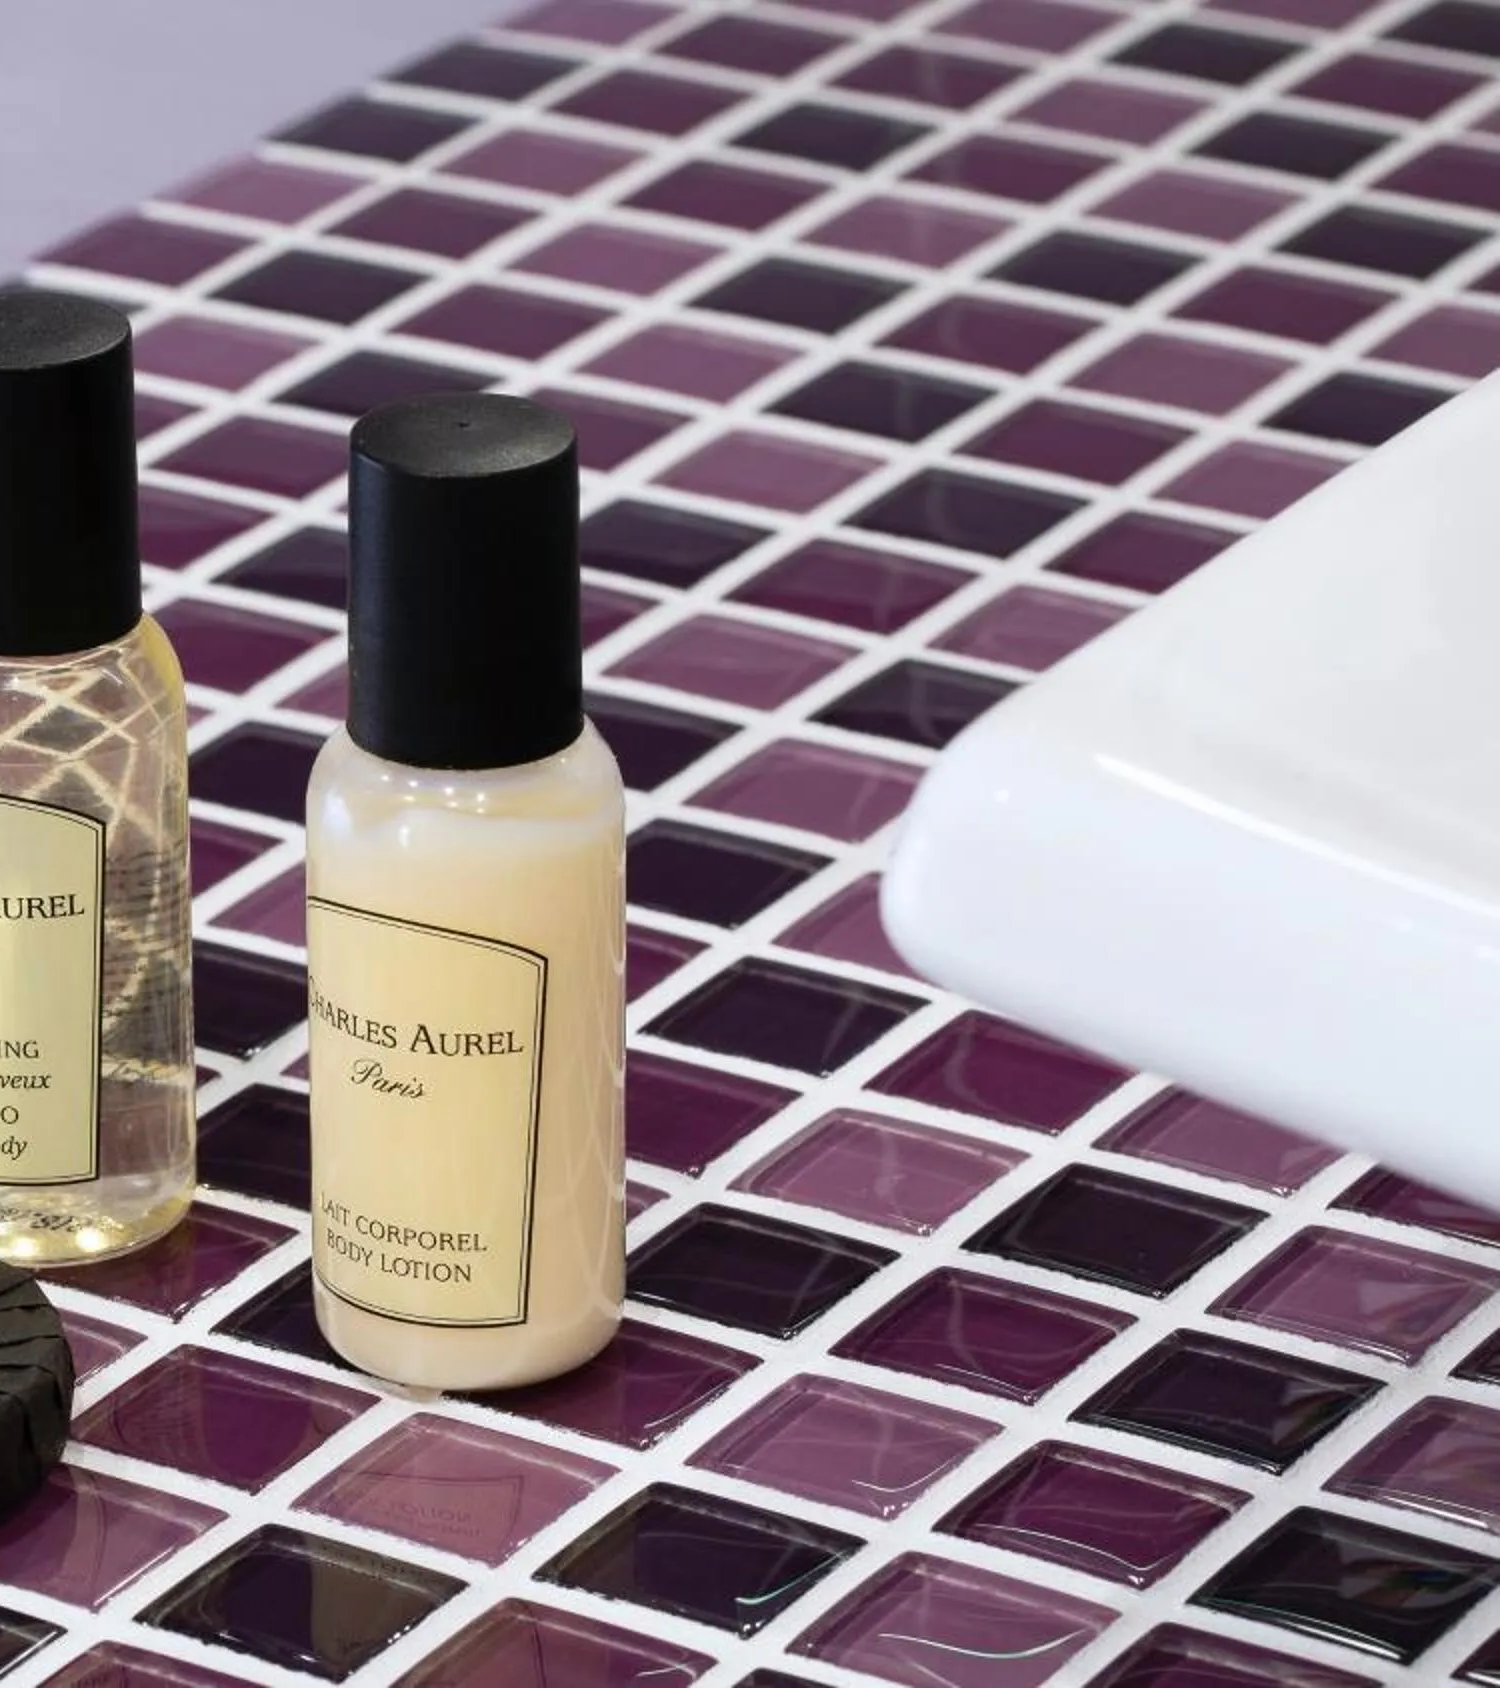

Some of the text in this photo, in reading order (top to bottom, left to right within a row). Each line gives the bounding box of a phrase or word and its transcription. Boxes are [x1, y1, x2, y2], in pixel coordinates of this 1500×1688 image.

[409, 1023, 525, 1057] AUREL
[351, 1057, 425, 1099] Paris
[320, 1191, 488, 1252] LAIT CORPOREL
[327, 1228, 472, 1283] BODY LOTION
